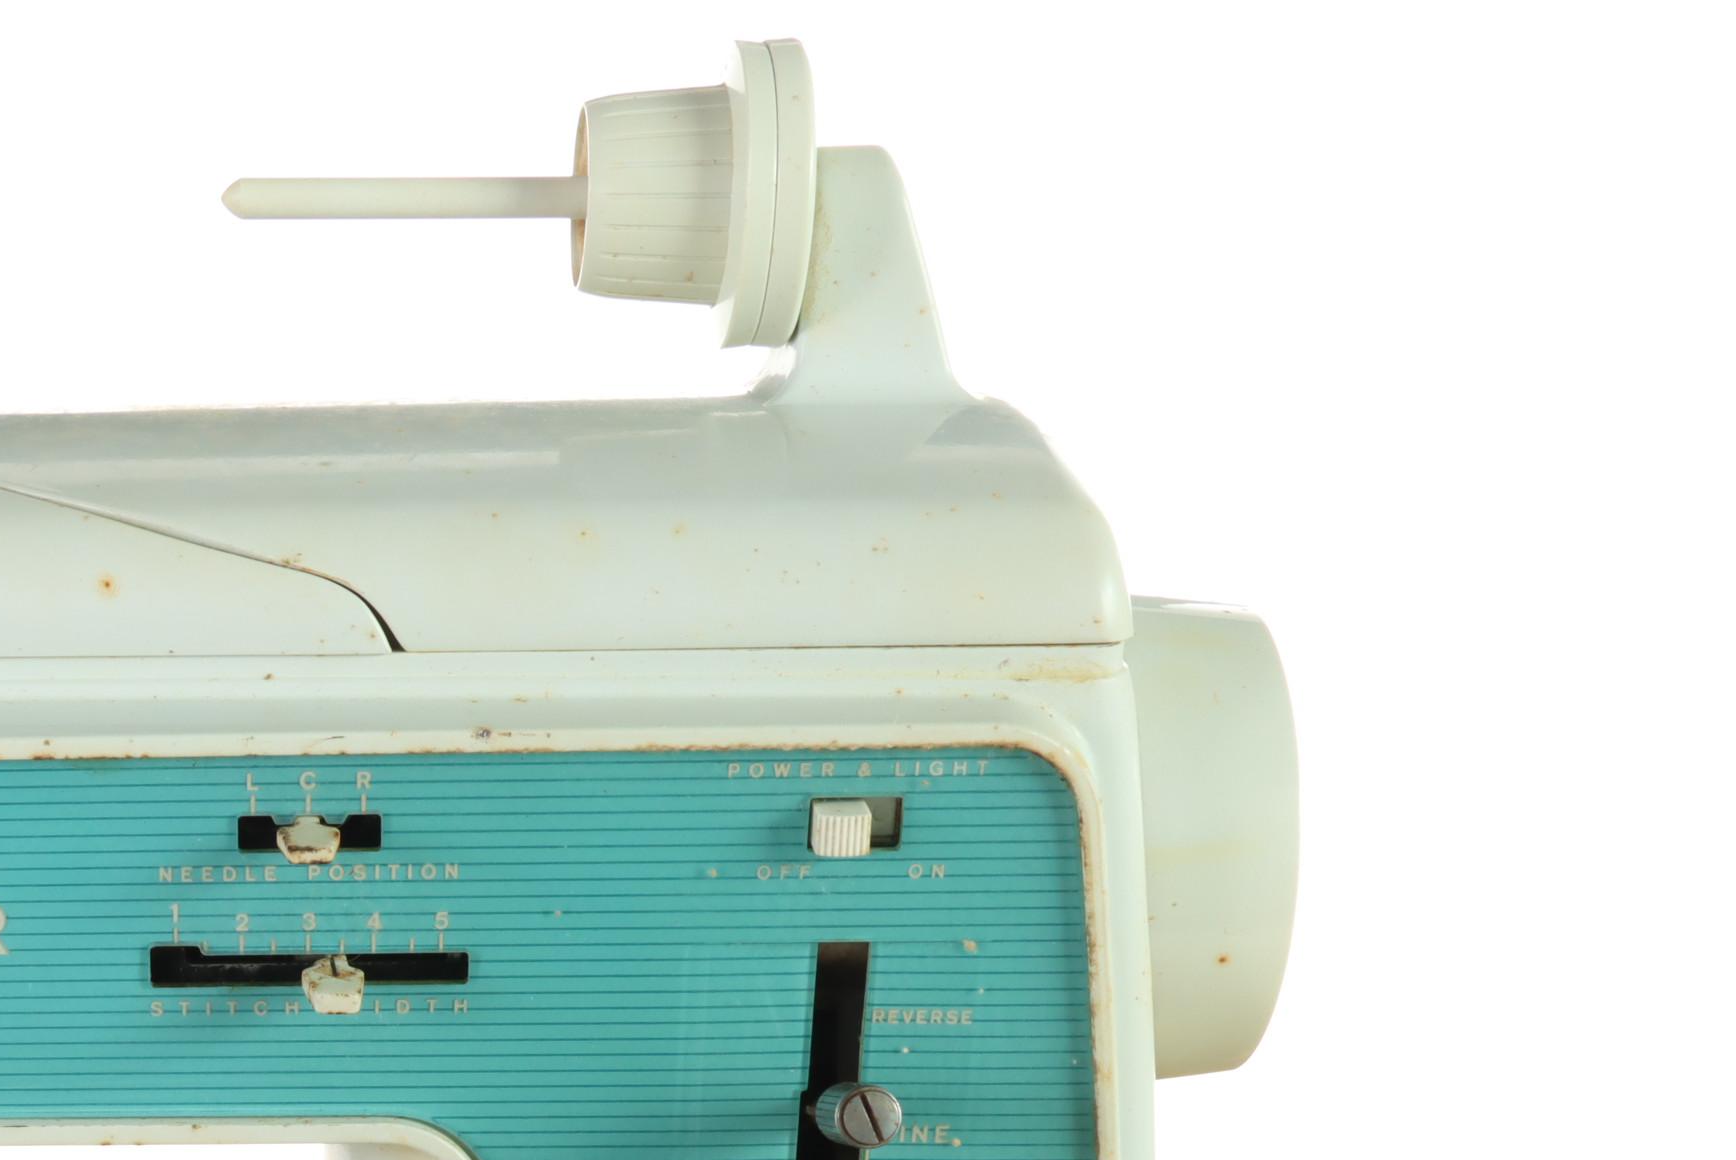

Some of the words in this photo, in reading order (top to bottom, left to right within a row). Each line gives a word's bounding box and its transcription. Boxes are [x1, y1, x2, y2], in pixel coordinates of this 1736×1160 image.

[727, 762, 835, 779] POWER
[857, 762, 872, 778] &
[894, 760, 990, 777] LIGHT
[246, 773, 260, 792] L
[299, 771, 316, 791] C
[356, 771, 372, 790] R
[159, 865, 278, 883] NEEDLE
[308, 863, 460, 882] POSITION
[756, 864, 812, 881] OFF
[907, 863, 946, 880] ON
[169, 903, 180, 924] 1
[234, 913, 250, 933] 2
[302, 912, 318, 932] 3
[367, 911, 383, 931] 4
[434, 910, 449, 931] 5
[150, 1000, 301, 1018] STITCH
[373, 998, 469, 1016] IDTH
[871, 1008, 974, 1025] REVERSE
[898, 1124, 951, 1145] INE
